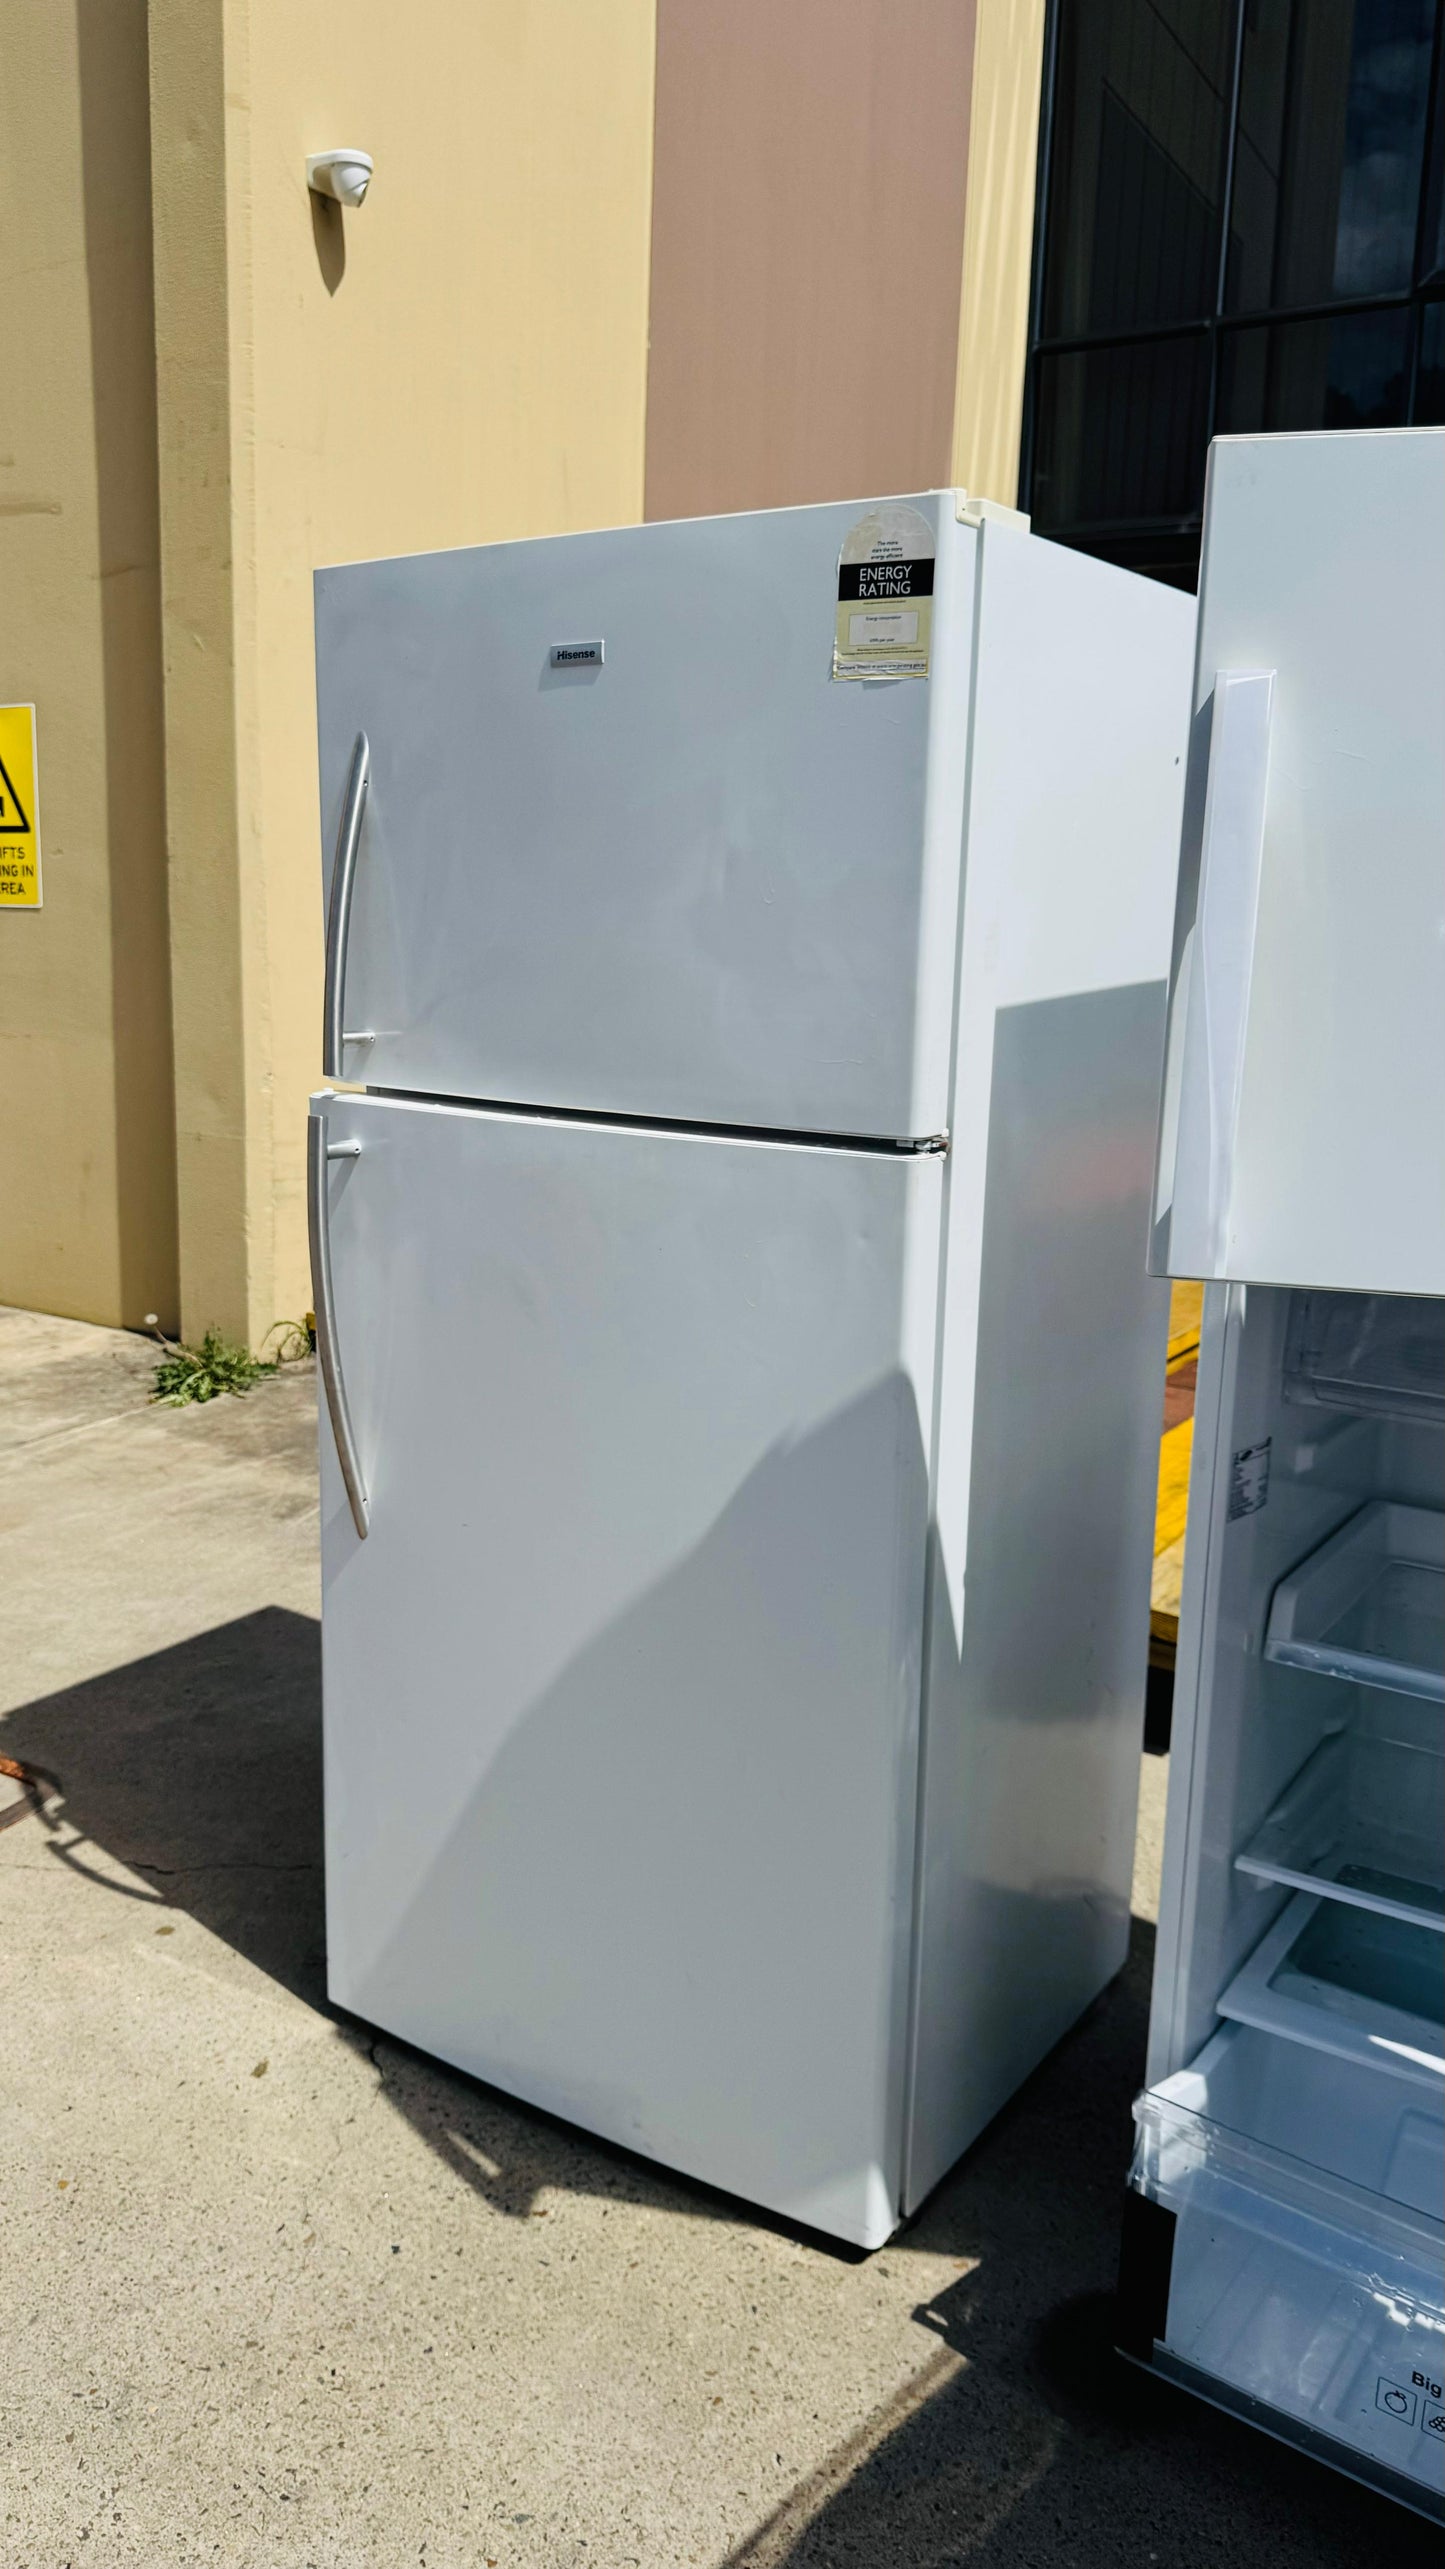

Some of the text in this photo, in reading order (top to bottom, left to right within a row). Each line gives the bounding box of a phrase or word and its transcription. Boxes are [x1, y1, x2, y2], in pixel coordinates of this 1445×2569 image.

[860, 564, 912, 582] ENERGY
[859, 580, 911, 597] RATING
[557, 650, 596, 661] Hisense
[22, 864, 34, 877] IN
[1411, 2370, 1443, 2399] Big
